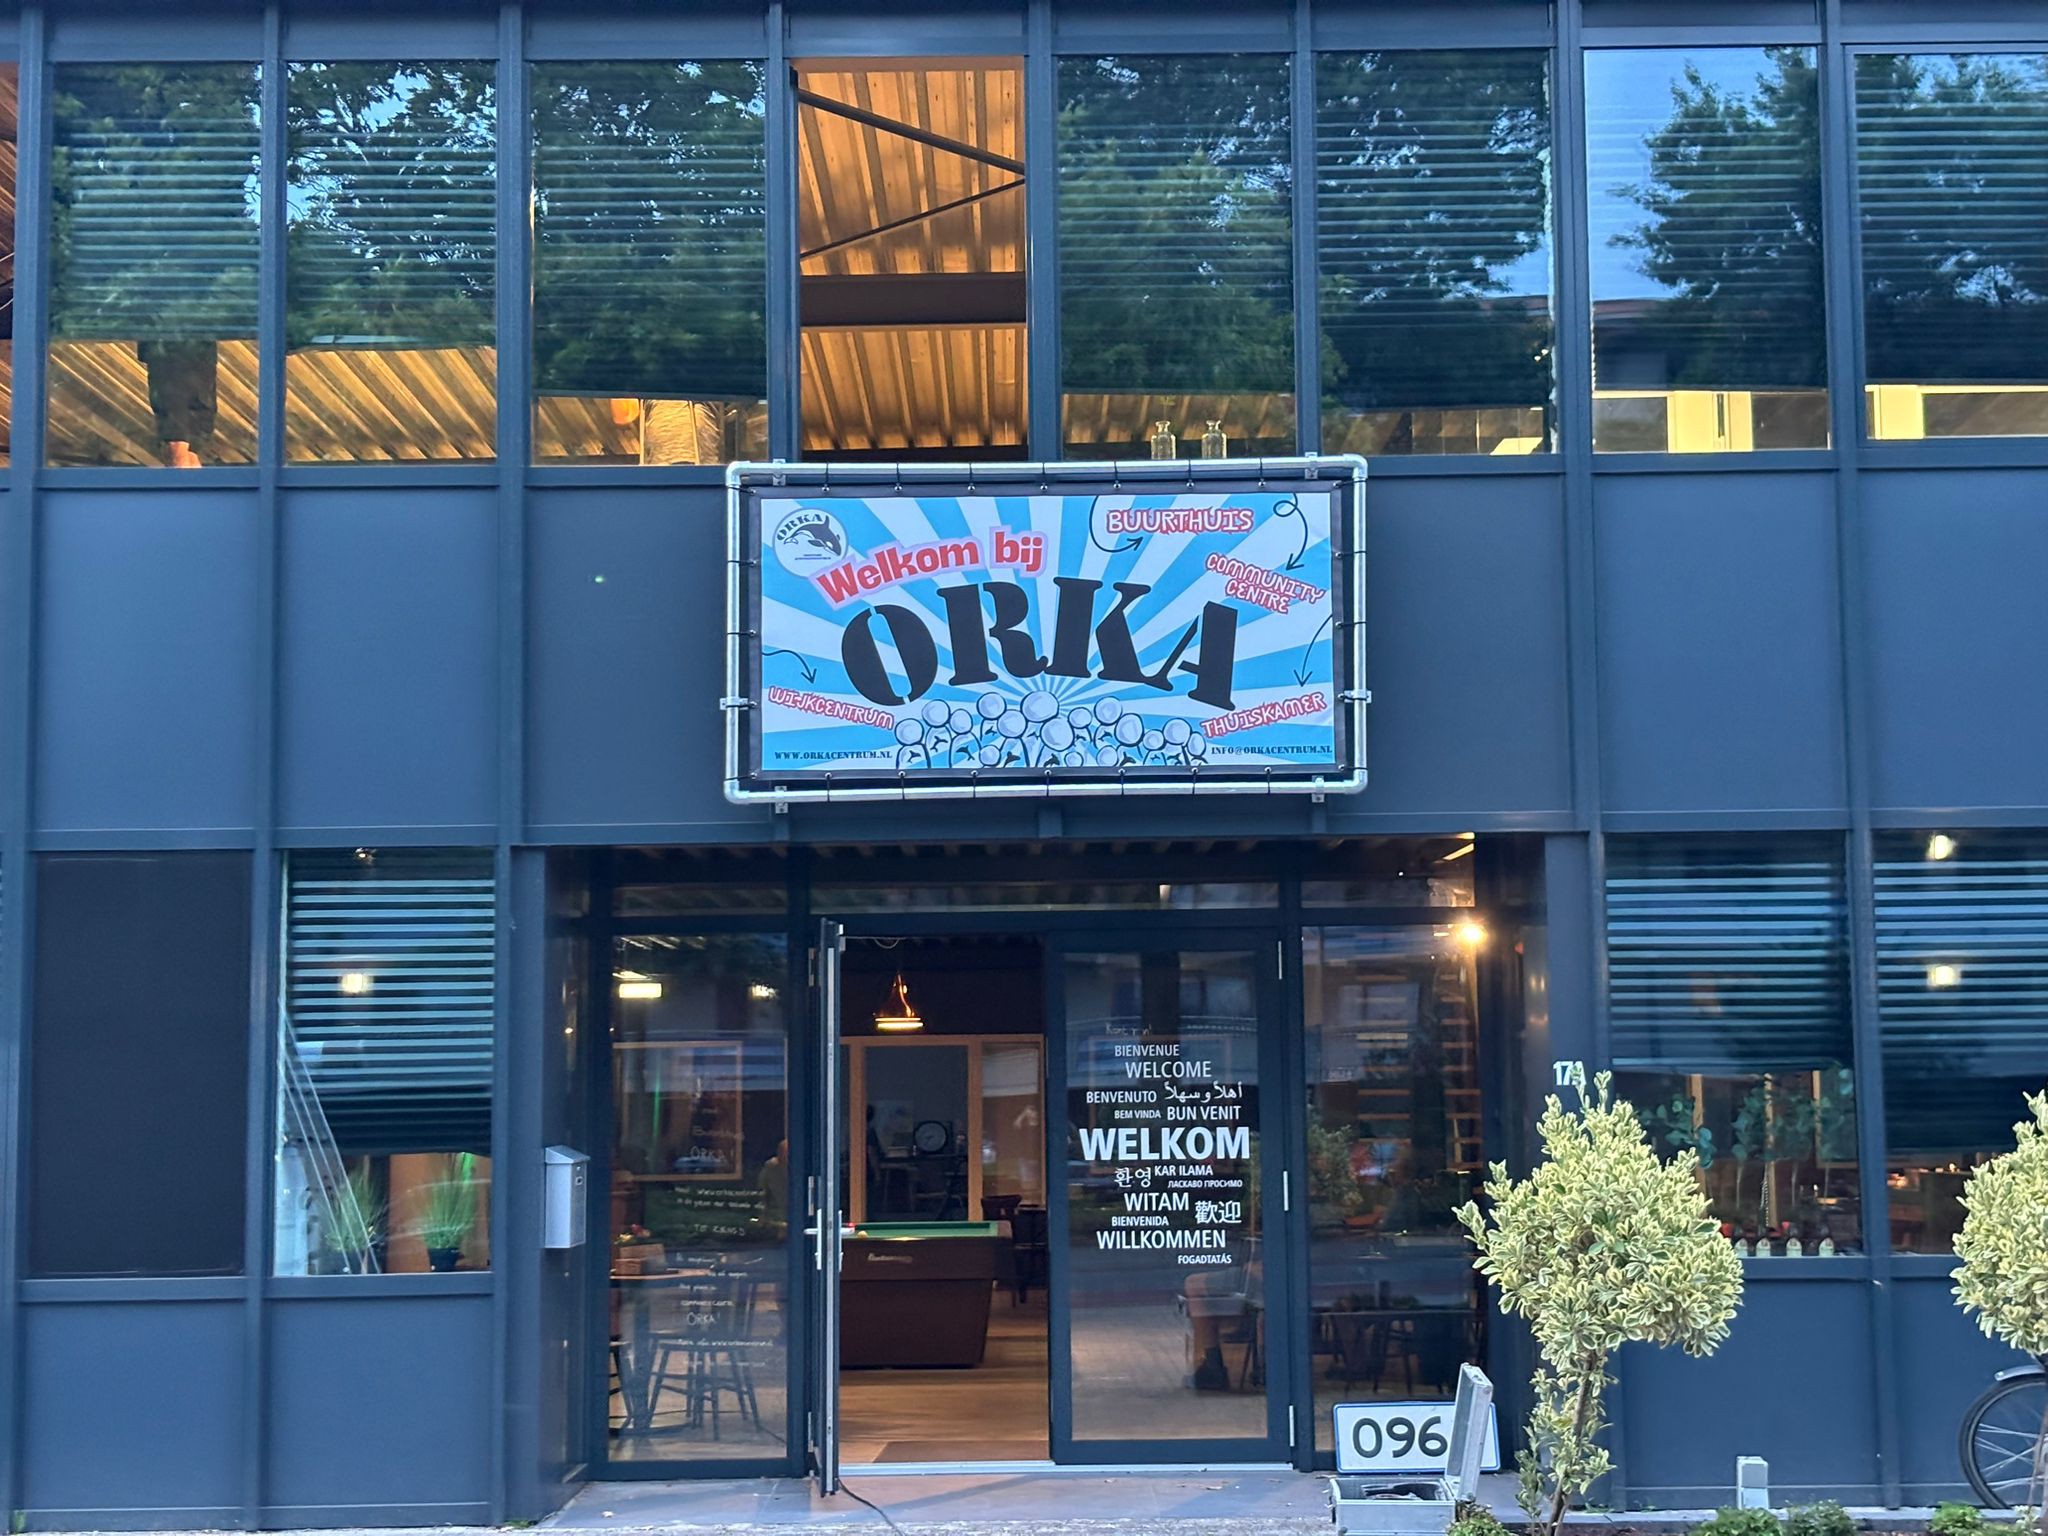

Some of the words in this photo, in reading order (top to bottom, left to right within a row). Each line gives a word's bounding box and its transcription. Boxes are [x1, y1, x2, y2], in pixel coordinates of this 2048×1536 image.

[777, 514, 823, 540] ORKA
[1107, 510, 1253, 533] BUURTHUIS
[816, 540, 980, 605] Welkom
[994, 531, 1043, 572] bij
[1206, 554, 1325, 603] COMMUNITY
[1225, 579, 1290, 613] CENTRE
[841, 576, 1238, 711] ORKA
[769, 687, 894, 730] WIJKCENTRUM
[1201, 693, 1326, 738] THUISKAMER
[775, 751, 892, 760] WWW.ORKACENTRUM.NL
[1211, 745, 1333, 755] INFO@ORKACENTRUM.NL
[1115, 1044, 1180, 1057] BIENVENUE
[1125, 1061, 1212, 1078] WELCOME
[1086, 1090, 1157, 1104] BENVENUTO
[1114, 1110, 1133, 1119] BEM
[1135, 1109, 1161, 1119] VINDA
[1167, 1106, 1197, 1121] BUN
[1200, 1105, 1241, 1120] VENIT
[1079, 1126, 1250, 1161] WELKOM
[1154, 1165, 1177, 1176] KAR
[1179, 1165, 1214, 1176] ILAMA
[1168, 1180, 1203, 1189] ЛАСКАВО
[1204, 1180, 1243, 1188] ПРОСИМО
[1124, 1192, 1189, 1211] WITAM
[1111, 1216, 1169, 1226] BIENVENIDA
[1194, 1200, 1242, 1224] 歡迎
[1096, 1230, 1226, 1249] WILLKOMMEN
[1178, 1254, 1232, 1264] FOGADTATÁS
